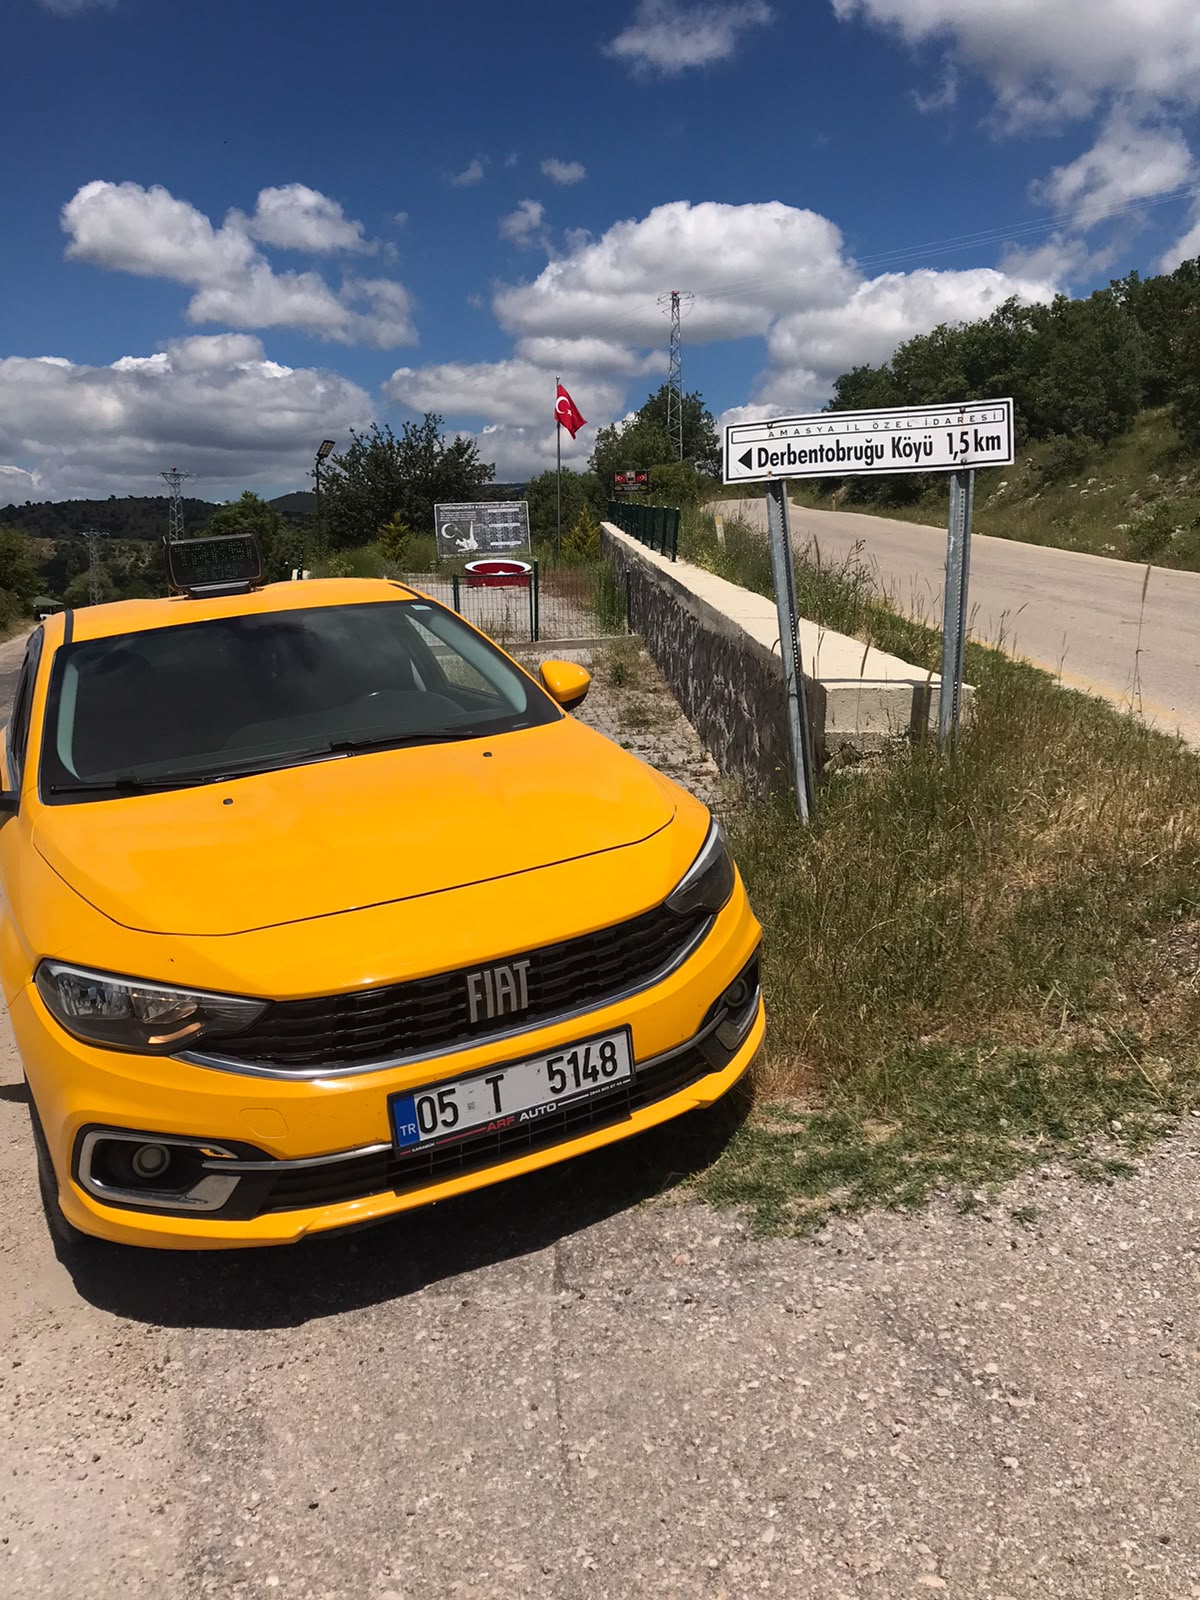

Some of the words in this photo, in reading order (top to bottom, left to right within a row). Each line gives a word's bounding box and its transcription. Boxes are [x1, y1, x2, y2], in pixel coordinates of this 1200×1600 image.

[768, 425, 834, 438] AMASYA
[846, 422, 860, 432] İL
[873, 420, 913, 430] ÖZEL
[925, 412, 998, 426] İDARESİ
[757, 438, 885, 468] Derbentobruğu
[891, 435, 933, 462] Köyü
[946, 431, 970, 461] 1,5
[973, 429, 1001, 452] km
[466, 959, 530, 1024] FIAT
[416, 1088, 459, 1134] 05
[485, 1074, 504, 1113] T
[546, 1040, 618, 1094] 5148
[399, 1123, 417, 1137] TR
[487, 1116, 515, 1133] ARF
[519, 1102, 557, 1122] AUTO
